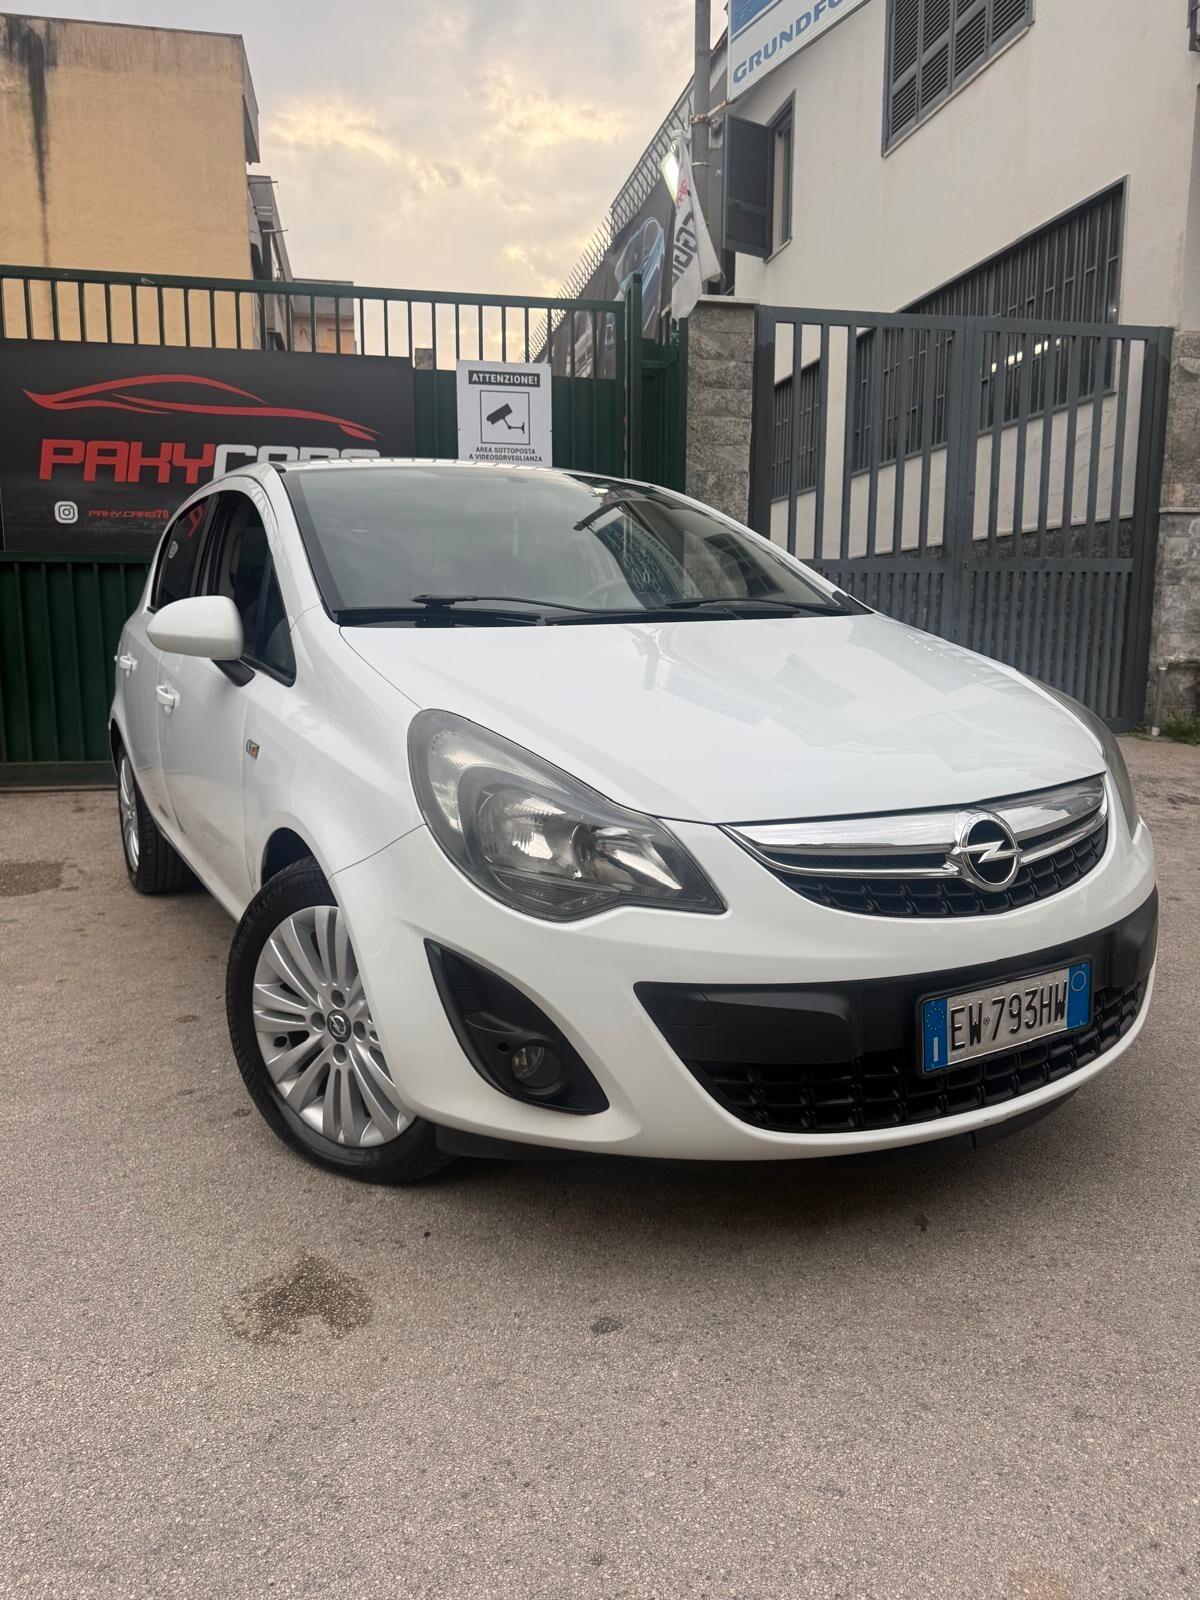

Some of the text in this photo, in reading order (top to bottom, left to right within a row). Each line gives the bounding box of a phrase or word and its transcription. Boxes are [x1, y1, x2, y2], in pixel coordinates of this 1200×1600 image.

[472, 373, 538, 385] ATTENZIONE!
[494, 447, 536, 455] SOTTOPOSTA
[475, 454, 543, 462] VIDEOSORVEGLIANZA
